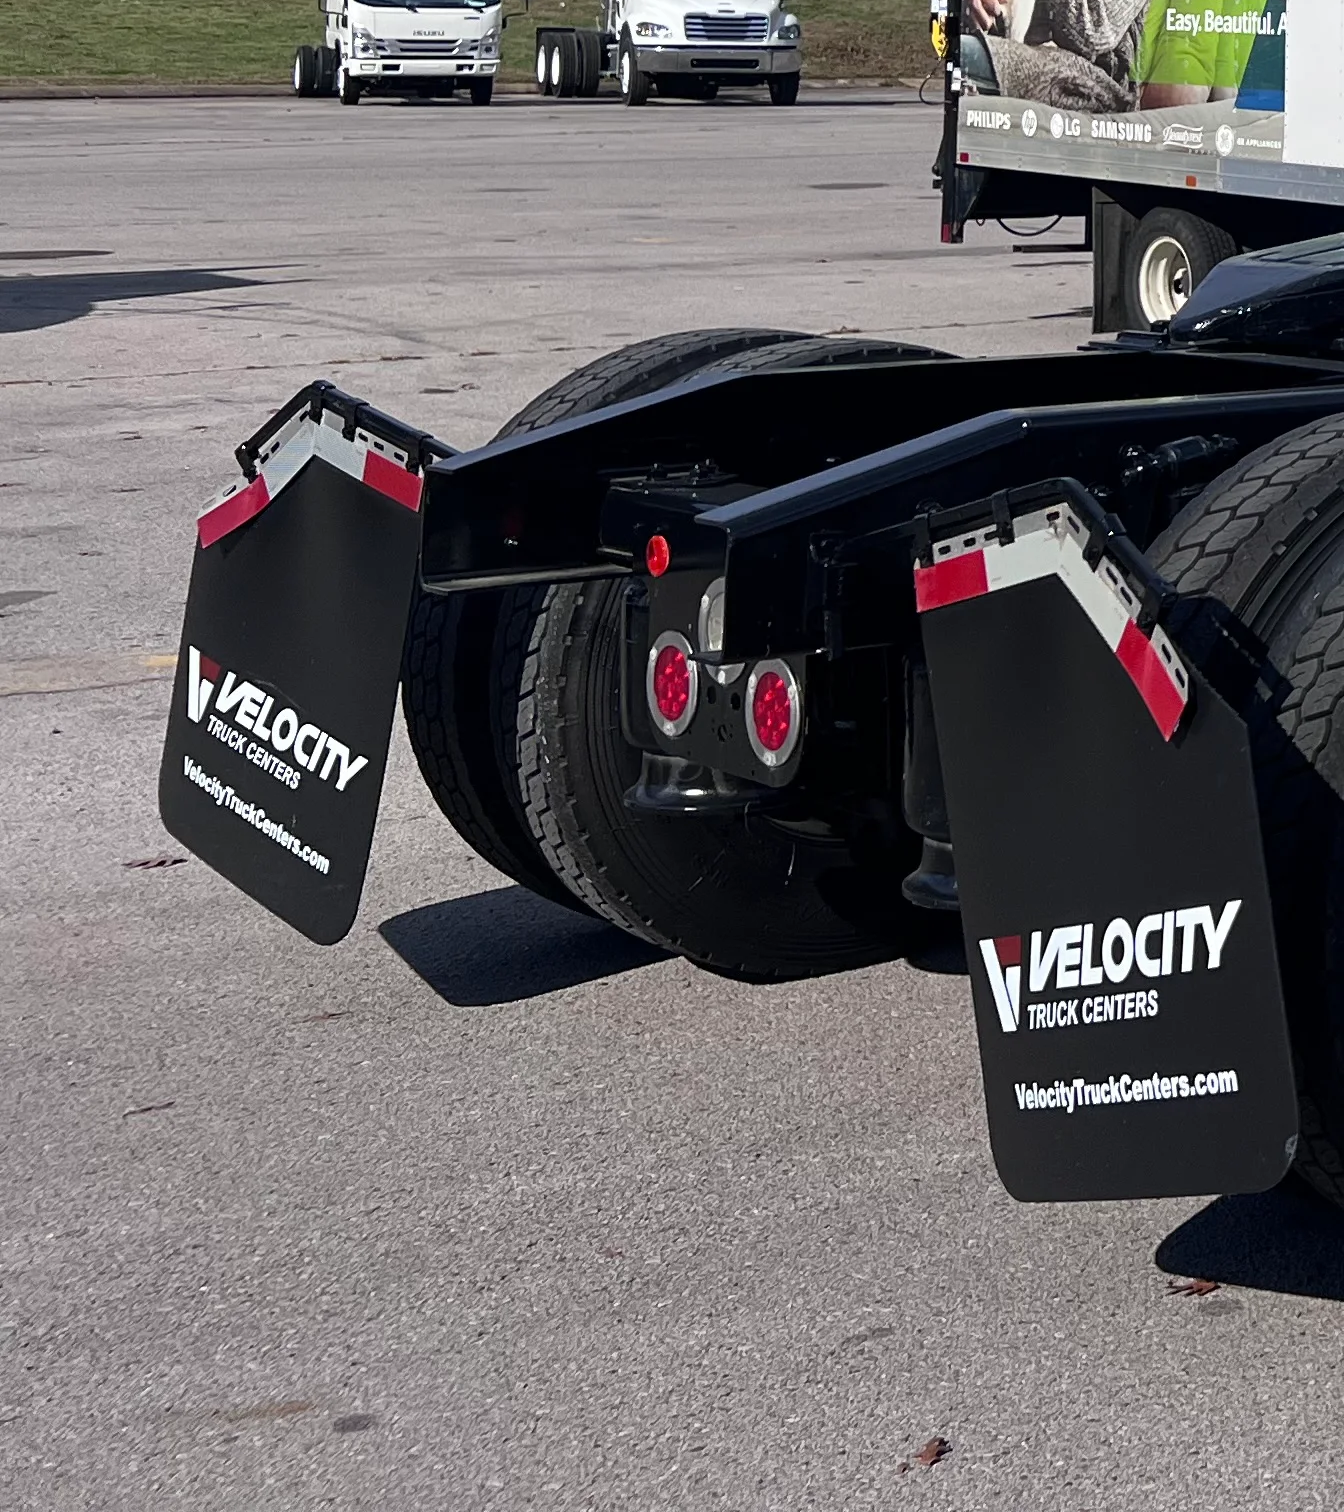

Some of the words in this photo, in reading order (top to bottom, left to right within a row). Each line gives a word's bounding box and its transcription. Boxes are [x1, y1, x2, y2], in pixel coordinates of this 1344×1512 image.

[1166, 7, 1202, 36] Easy.
[1204, 9, 1275, 35] Beautiful.
[966, 109, 1012, 130] PHILIPS
[1064, 118, 1081, 136] LG
[1091, 119, 1152, 143] SAMSUNG
[1245, 138, 1282, 149] APPLIANCES
[206, 714, 249, 755] TRUCK
[245, 741, 302, 790] CENTERS
[214, 670, 369, 792] VELOCITY
[182, 754, 331, 876] VelocityTruckCenters.com
[1028, 899, 1242, 993] VELOCITY
[1027, 998, 1079, 1030] TRUCK
[1081, 988, 1159, 1025] CENTERS
[1014, 1069, 1239, 1114] VelocityTruckCenters.com
